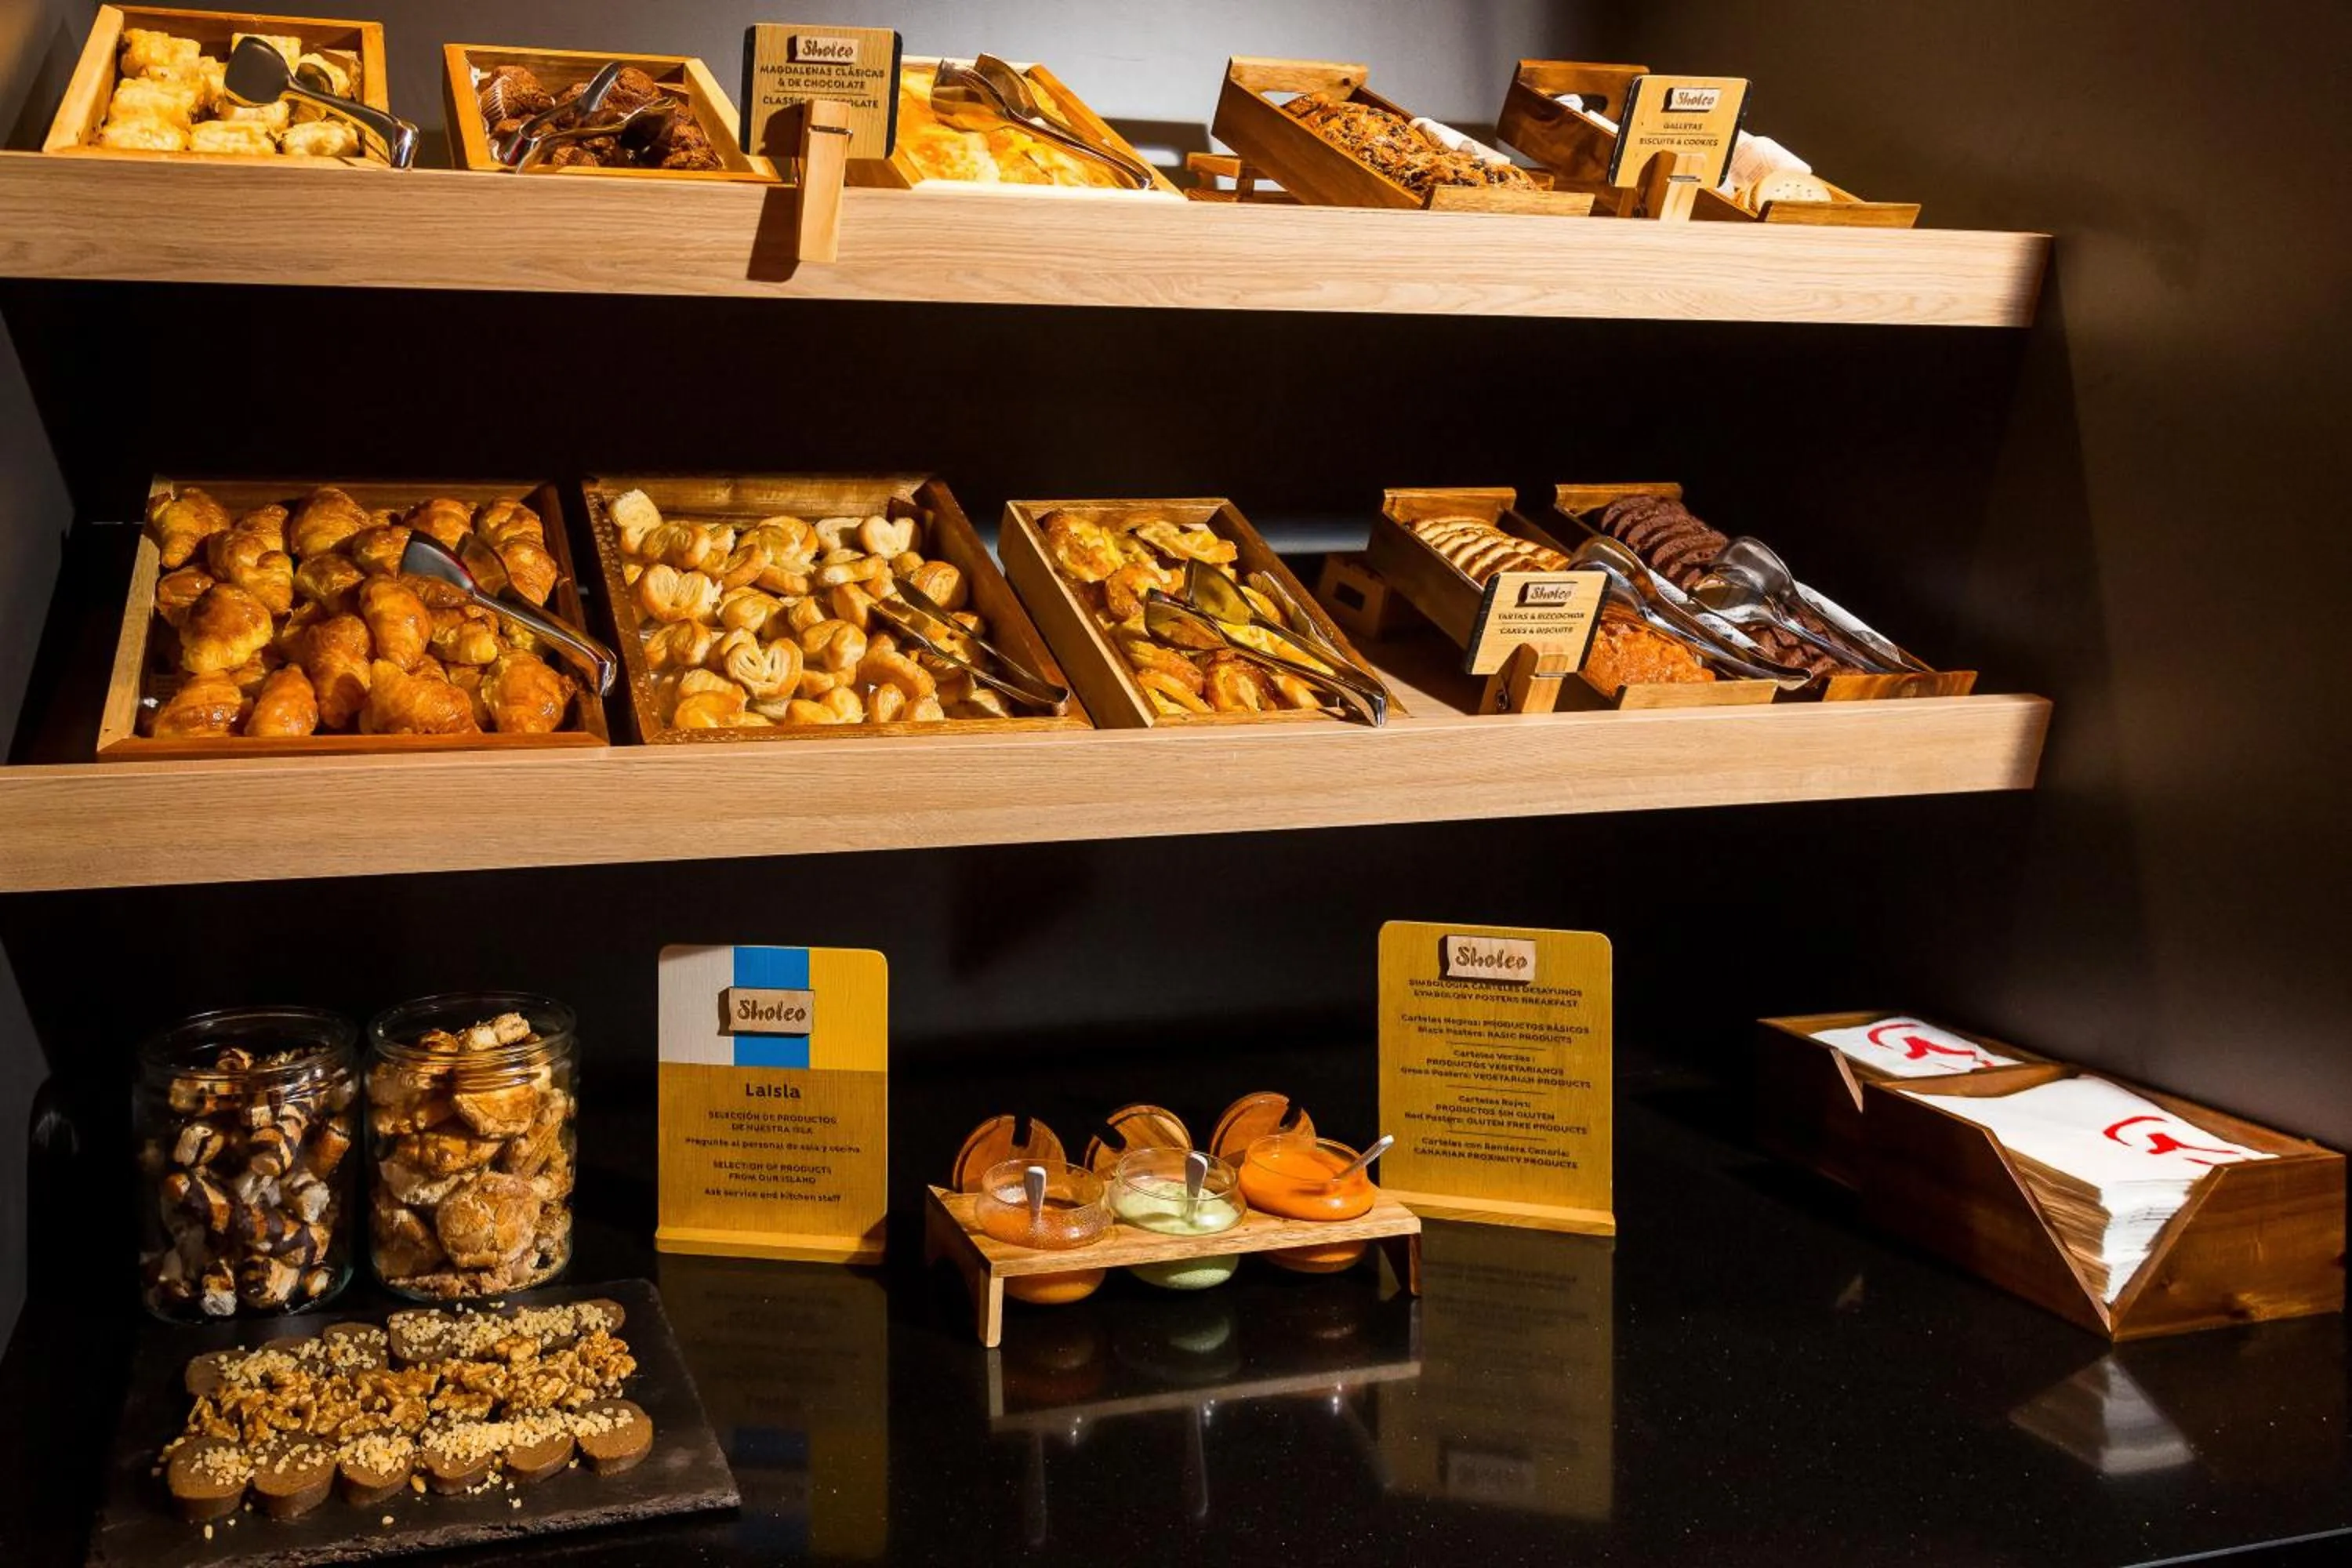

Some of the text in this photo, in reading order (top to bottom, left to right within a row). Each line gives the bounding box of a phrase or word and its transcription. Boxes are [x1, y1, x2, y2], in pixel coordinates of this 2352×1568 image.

[760, 65, 832, 77] MAGDALENAS
[778, 78, 866, 89] & DE CHOCOLATE
[1683, 138, 1719, 147] COOKIES
[1523, 985, 1582, 997] DESAYUNOS
[1475, 993, 1519, 1004] POSTERS
[1521, 996, 1578, 1007] BREAKFAST
[1401, 1014, 1441, 1024] Carteles
[1483, 1019, 1544, 1031] PRODUCTOS
[1546, 1022, 1589, 1034] BÁSICOS
[1487, 1030, 1517, 1040] BASIC
[1519, 1033, 1572, 1044] PRODUCTS
[1453, 1049, 1494, 1059] Carteles
[1425, 1058, 1564, 1076] PRODUCTOS VEGETARIANOS
[1473, 1073, 1534, 1084] VEGETARIAN
[1537, 1077, 1591, 1089] PRODUCTS
[1458, 1095, 1499, 1105] Carteles
[1436, 1104, 1555, 1121] PRODUCTOS SIN GLUTEN
[778, 1114, 837, 1124] PRODUCTOS
[731, 1123, 746, 1131] DE
[746, 1123, 789, 1134] NUESTRA
[1466, 1117, 1504, 1127] GLUTEN
[1506, 1120, 1531, 1130] FREE
[1533, 1123, 1588, 1135] PRODUCTS
[742, 1140, 784, 1150] personal
[1421, 1137, 1462, 1148] Carteles
[1414, 1147, 1578, 1169] CANARIAN PROXIMITY PRODUCTS
[713, 1160, 764, 1170] SELECTION
[780, 1163, 832, 1174] PRODUCTS
[728, 1172, 757, 1181] FROM
[781, 1174, 816, 1184] ISLAND
[818, 1193, 841, 1203] staff
